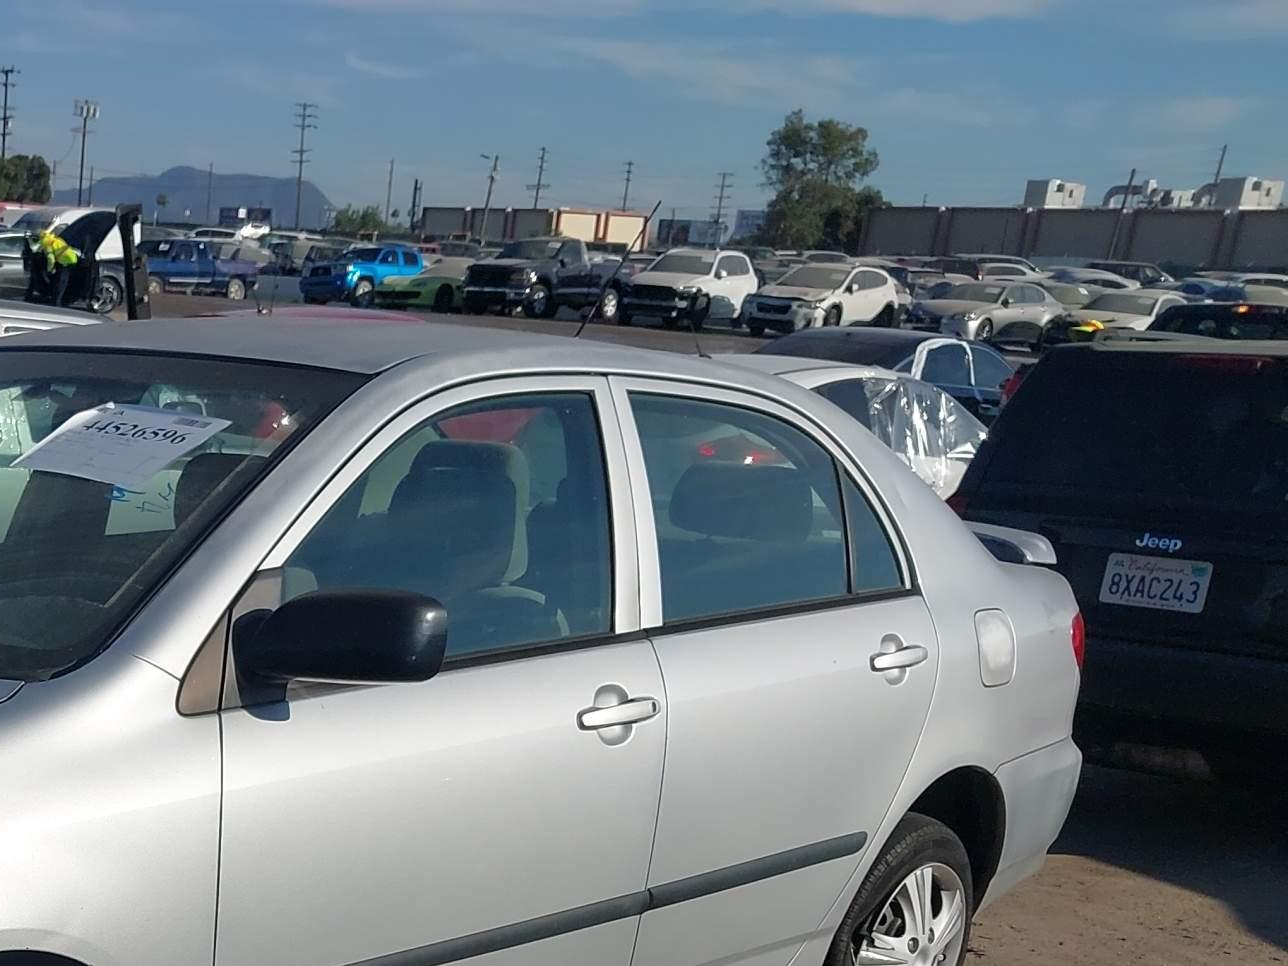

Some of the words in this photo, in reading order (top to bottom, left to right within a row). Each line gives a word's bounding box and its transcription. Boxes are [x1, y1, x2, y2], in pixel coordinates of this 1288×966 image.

[82, 420, 192, 445] 44526596
[1135, 532, 1182, 552] Jeep
[1108, 572, 1201, 604] 8XAC243
